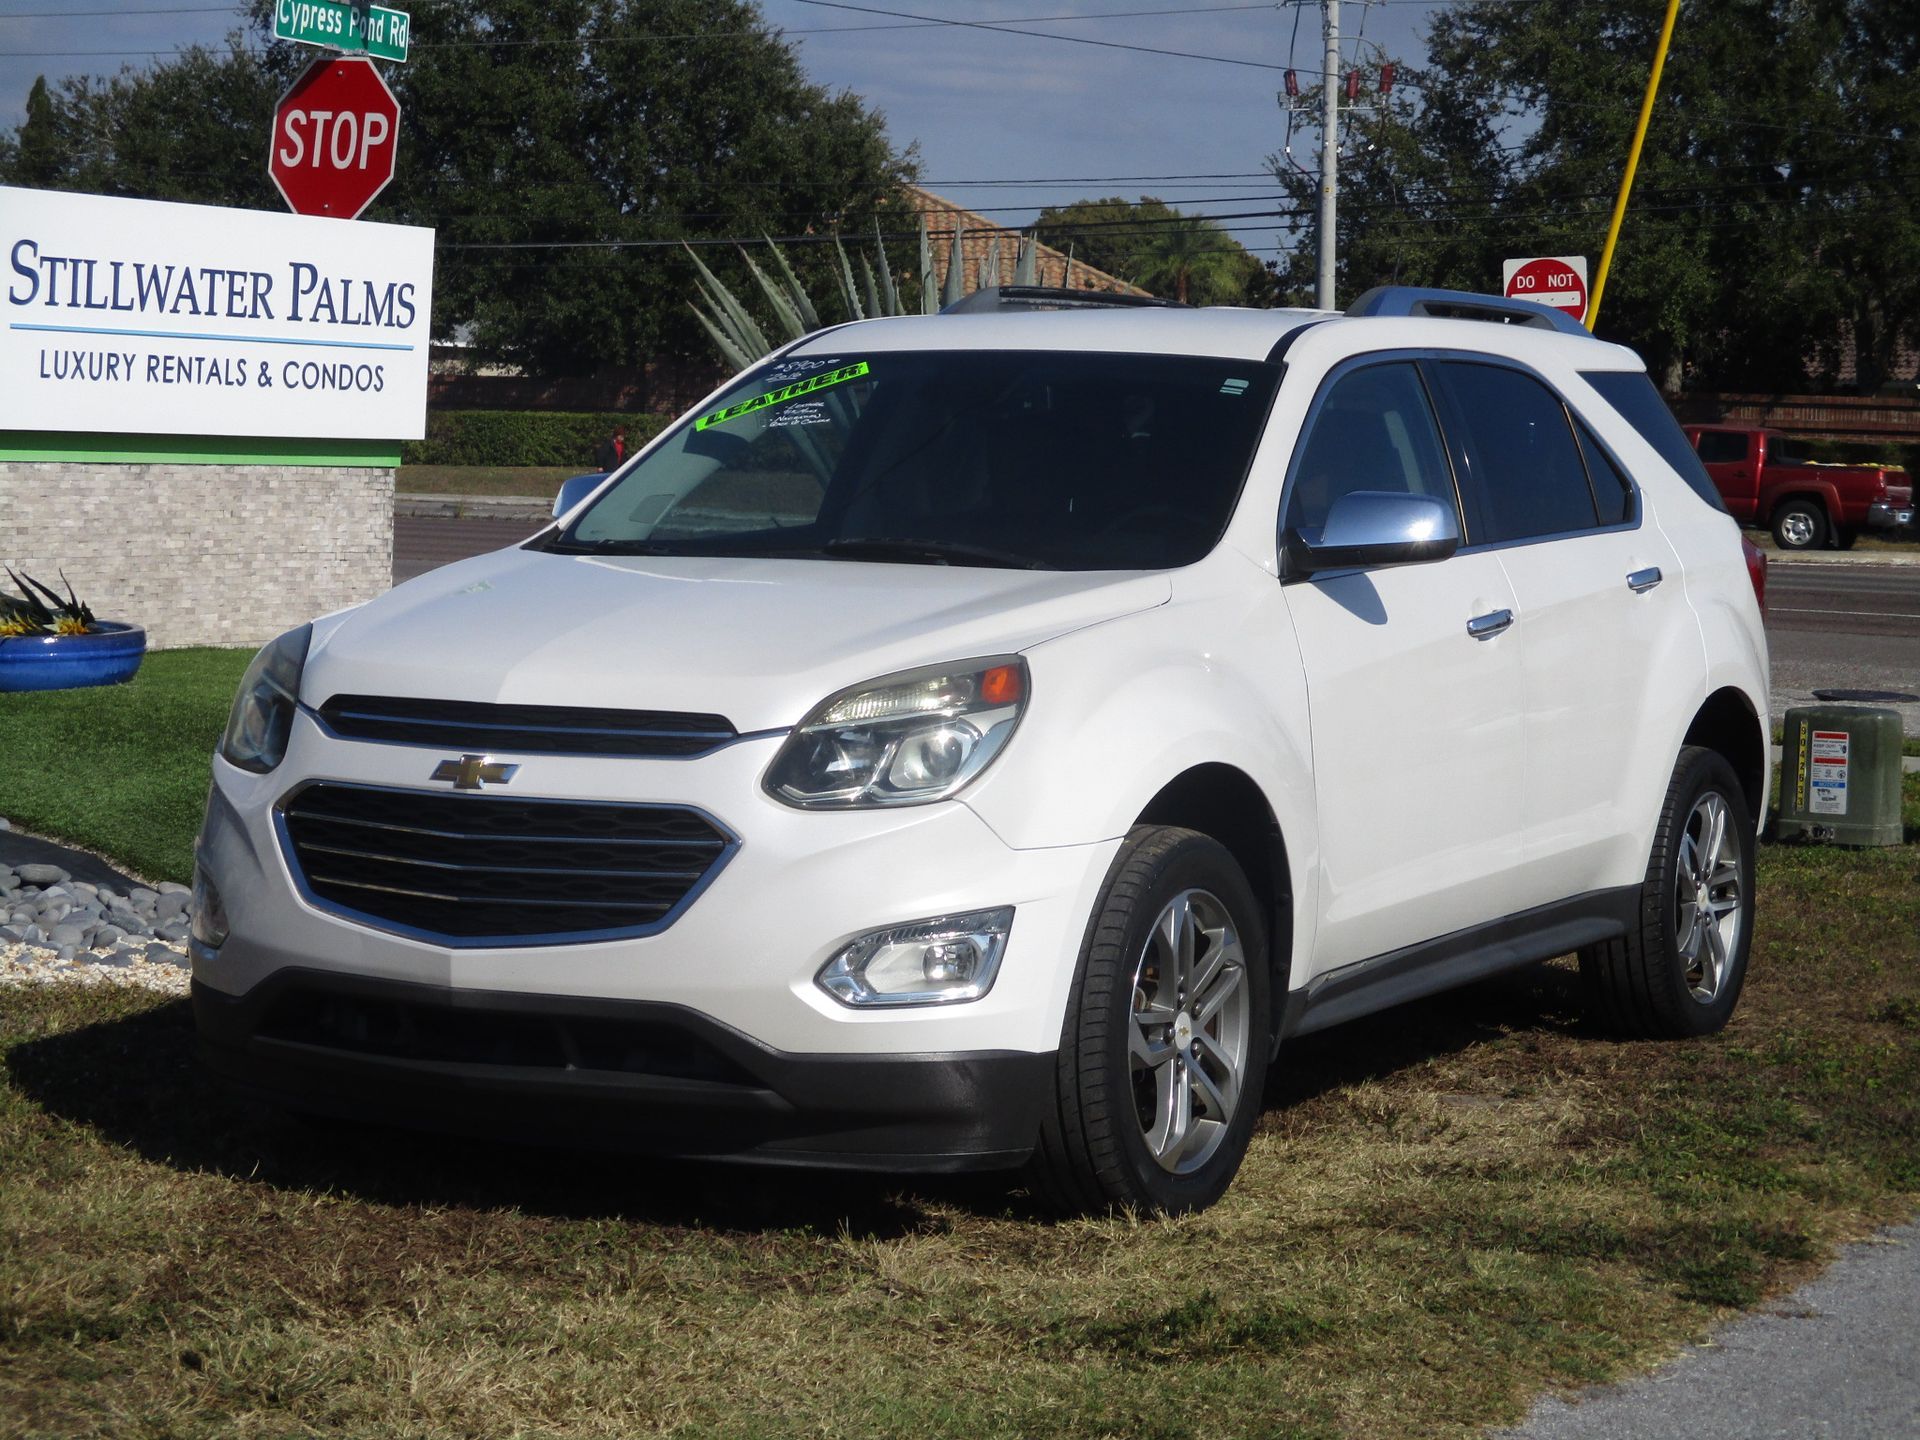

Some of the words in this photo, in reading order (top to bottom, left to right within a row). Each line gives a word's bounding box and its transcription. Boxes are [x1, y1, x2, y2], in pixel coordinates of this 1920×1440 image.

[279, 0, 342, 35] Cypress
[349, 7, 384, 43] Pond
[390, 15, 407, 48] Rd
[279, 110, 389, 170] STOP
[9, 239, 274, 320] STILLWATER
[286, 262, 416, 329] PALMS
[1517, 275, 1535, 289] DO
[1548, 273, 1574, 287] NOT
[40, 349, 136, 382] LUXURY
[147, 354, 247, 387] RENTALS
[257, 362, 273, 388] &
[282, 360, 385, 392] CONDOS
[704, 364, 865, 427] LEATHER
